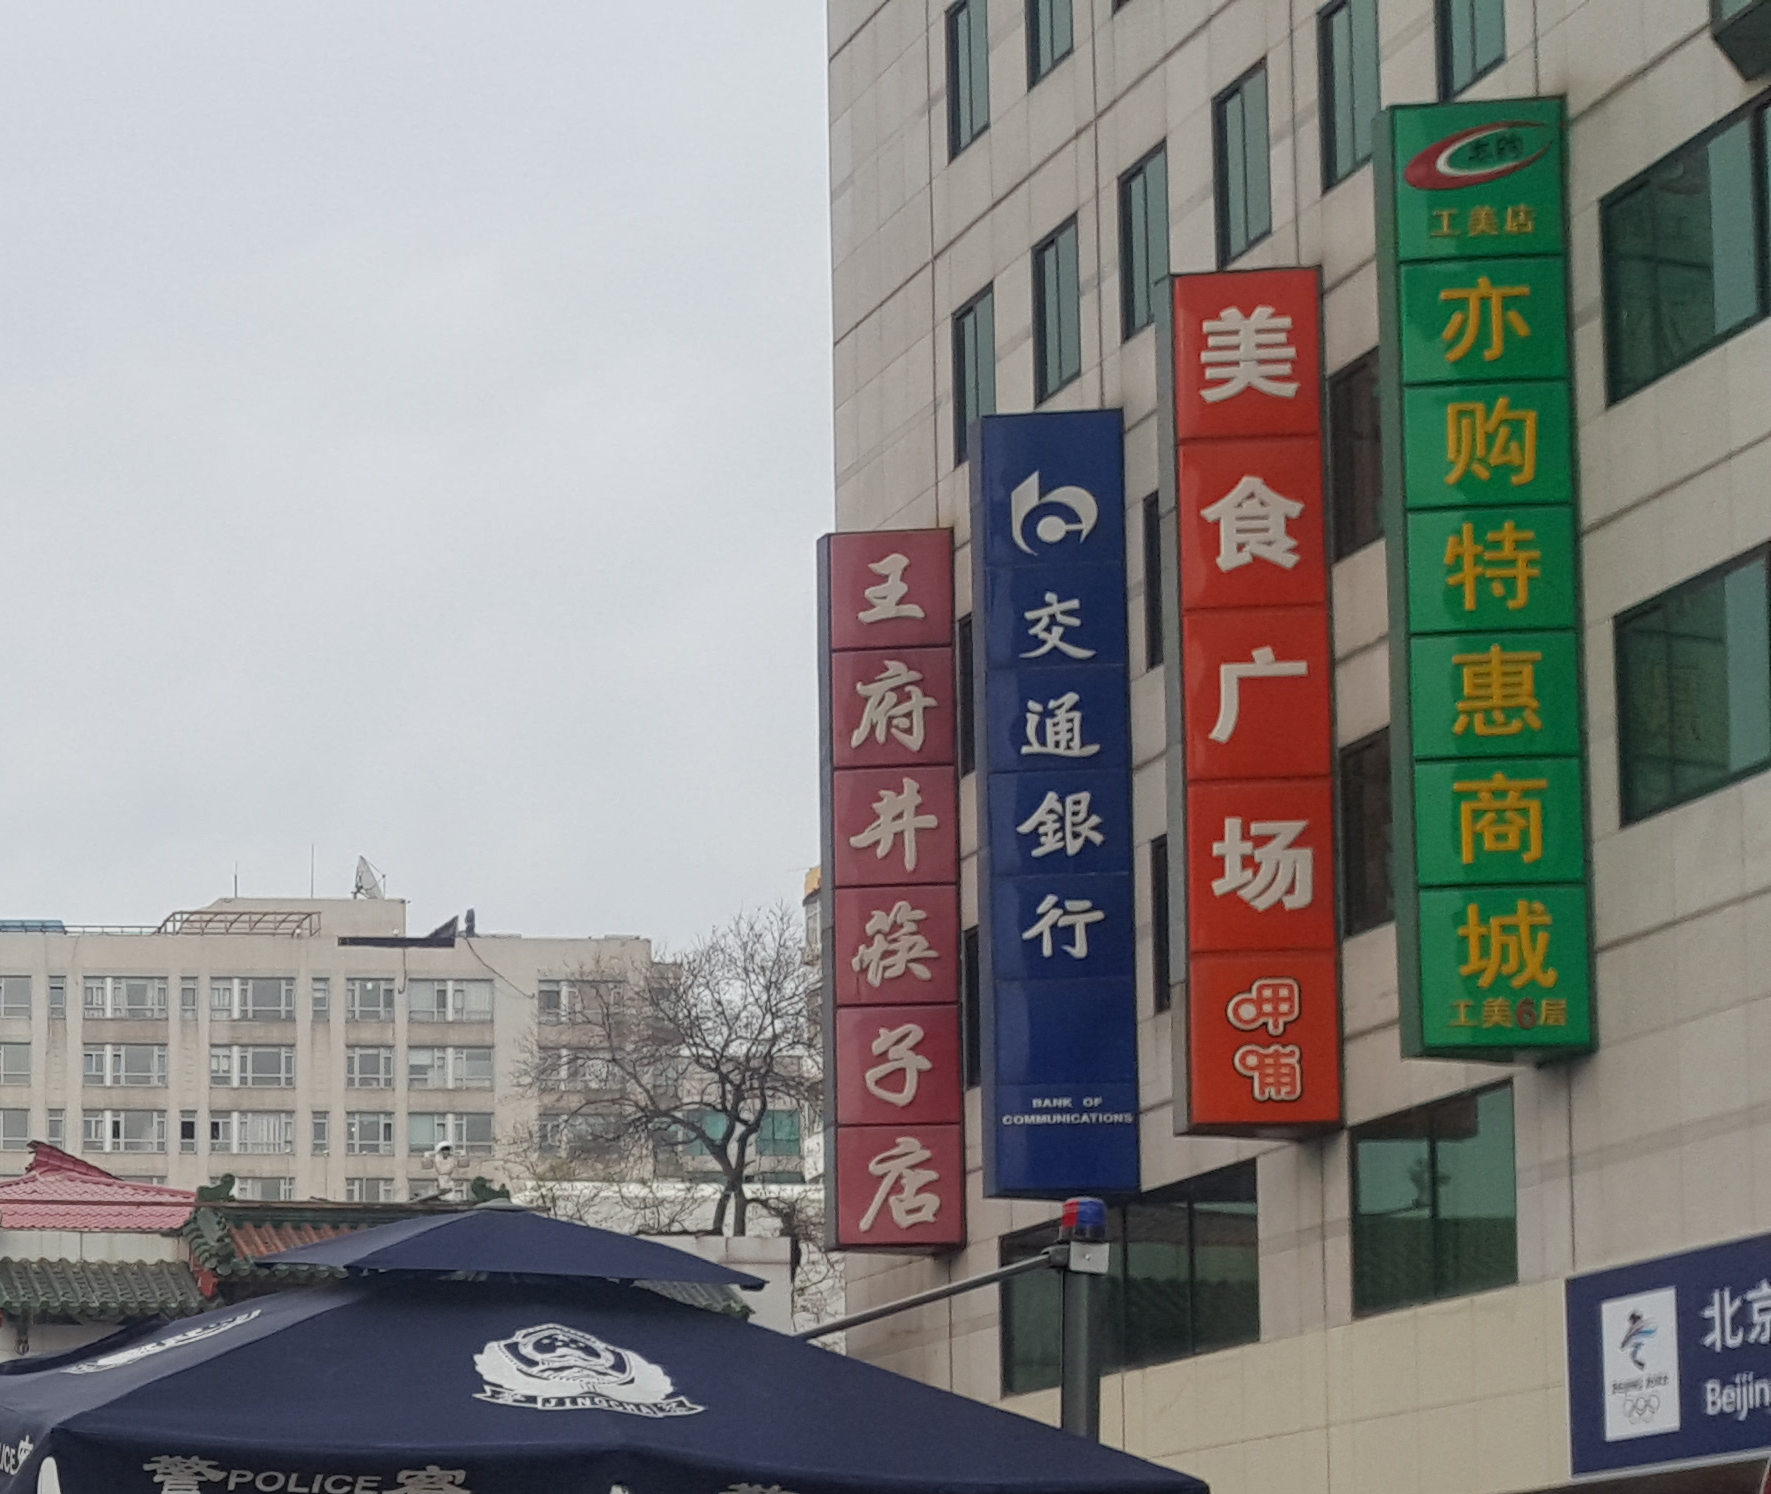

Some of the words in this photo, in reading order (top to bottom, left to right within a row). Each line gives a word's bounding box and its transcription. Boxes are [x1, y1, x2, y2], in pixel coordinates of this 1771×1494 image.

[1430, 203, 1536, 238] 工美店
[1199, 305, 1314, 912] 美食广场
[1438, 276, 1558, 990] 亦购特惠商城
[1015, 591, 1107, 959] 交通銀行
[849, 552, 942, 1232] 王府井筷子店
[1449, 997, 1567, 1031] 工美6层
[1001, 1113, 1134, 1126] COMMUNICATIONS
[1032, 1097, 1073, 1109] BANK
[1083, 1096, 1103, 1108] OF
[545, 1396, 653, 1415] JINGCHA
